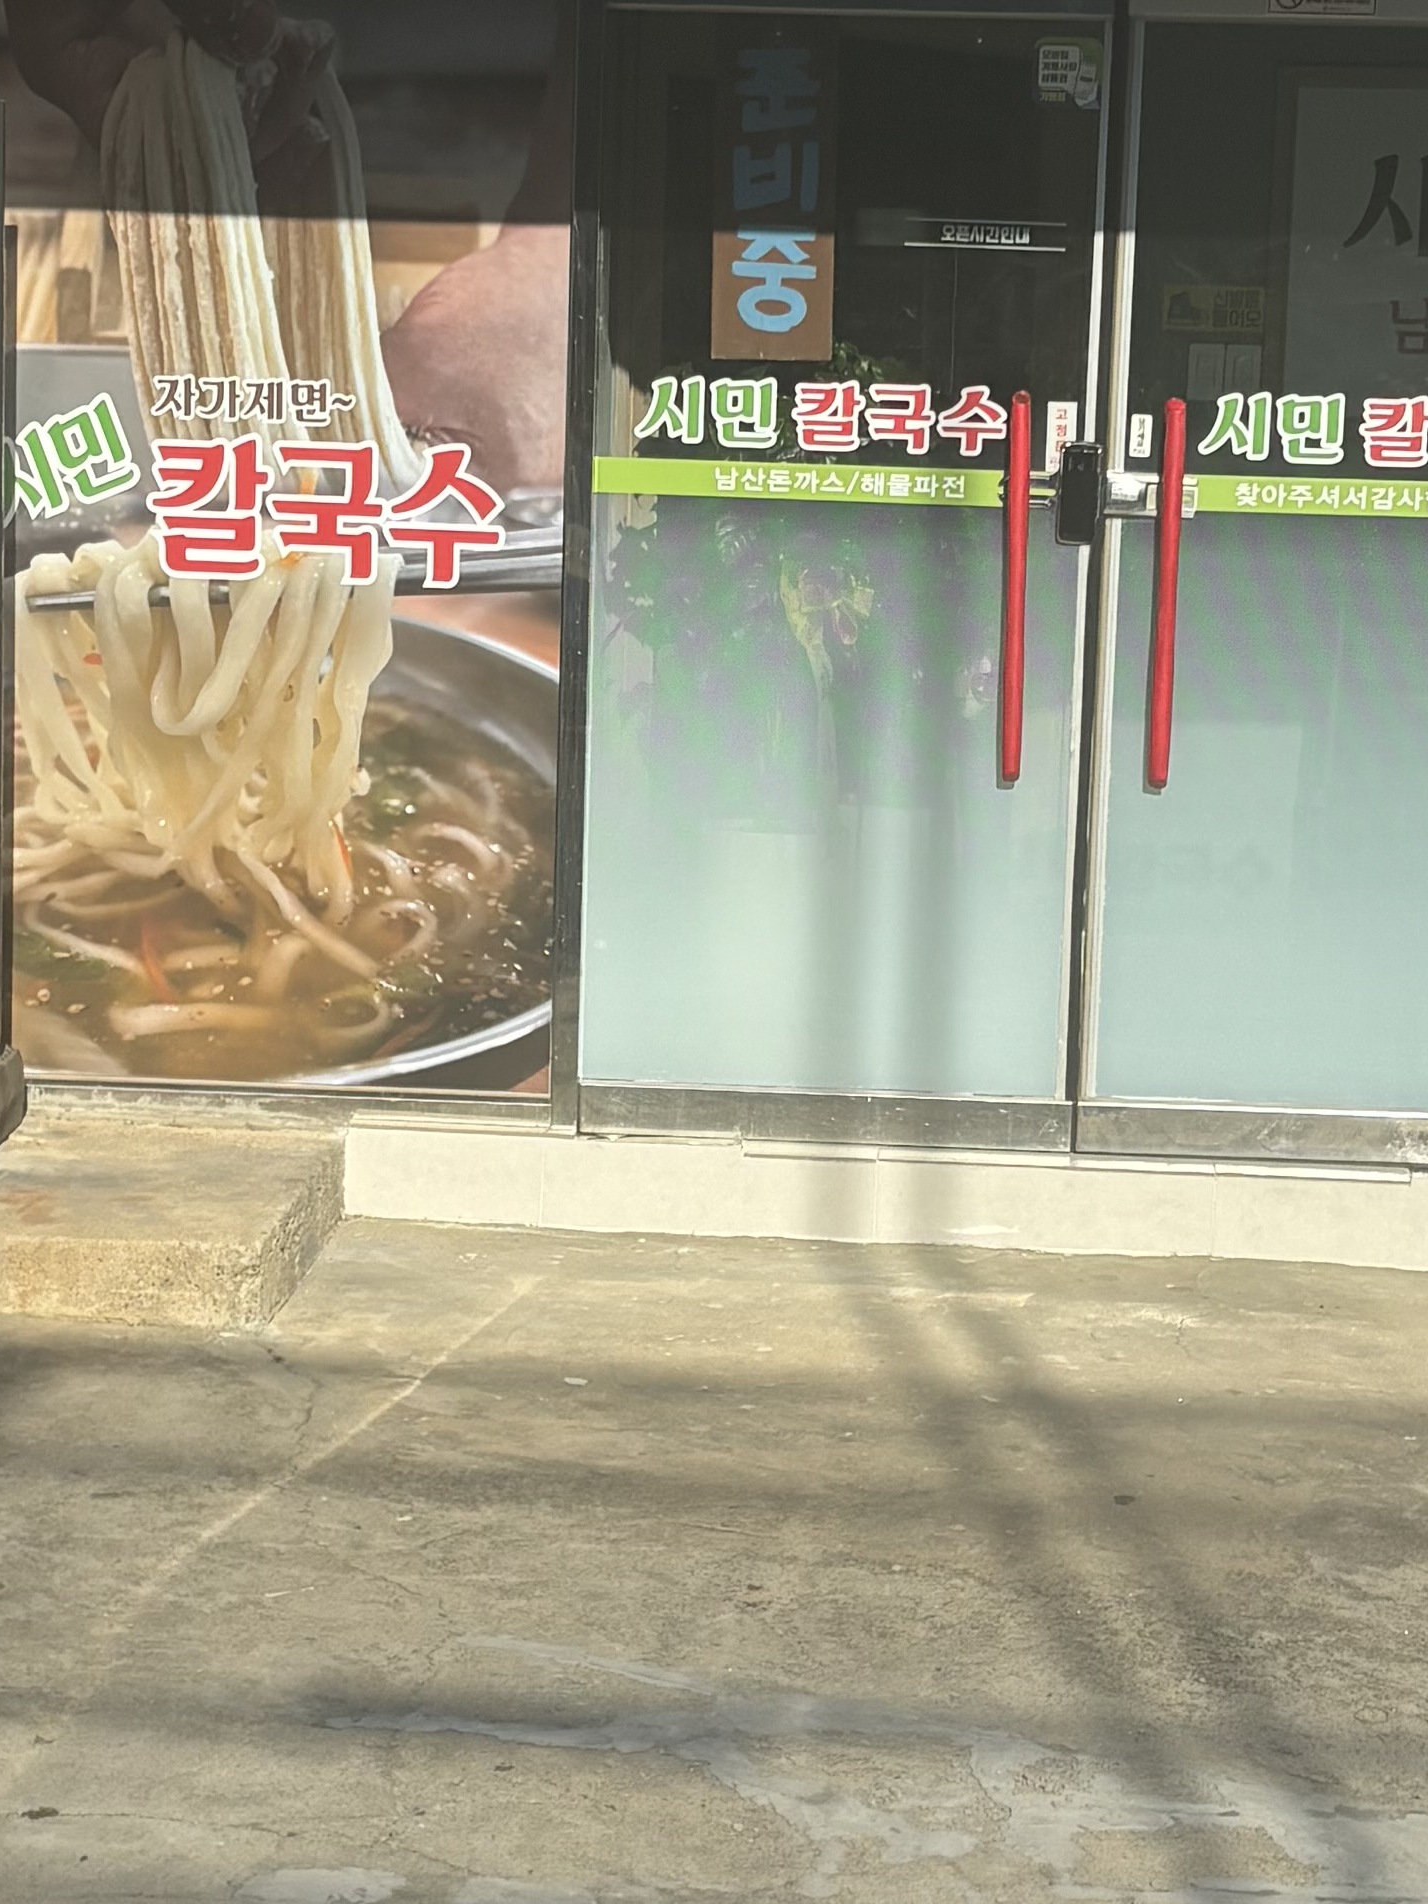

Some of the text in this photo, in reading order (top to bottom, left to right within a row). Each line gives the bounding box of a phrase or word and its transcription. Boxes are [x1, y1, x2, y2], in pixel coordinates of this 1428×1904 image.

[731, 47, 822, 334] 준비중
[637, 377, 1007, 454] 시민 칼국수
[1199, 393, 1345, 464] 시민
[152, 438, 501, 585] 칼국수
